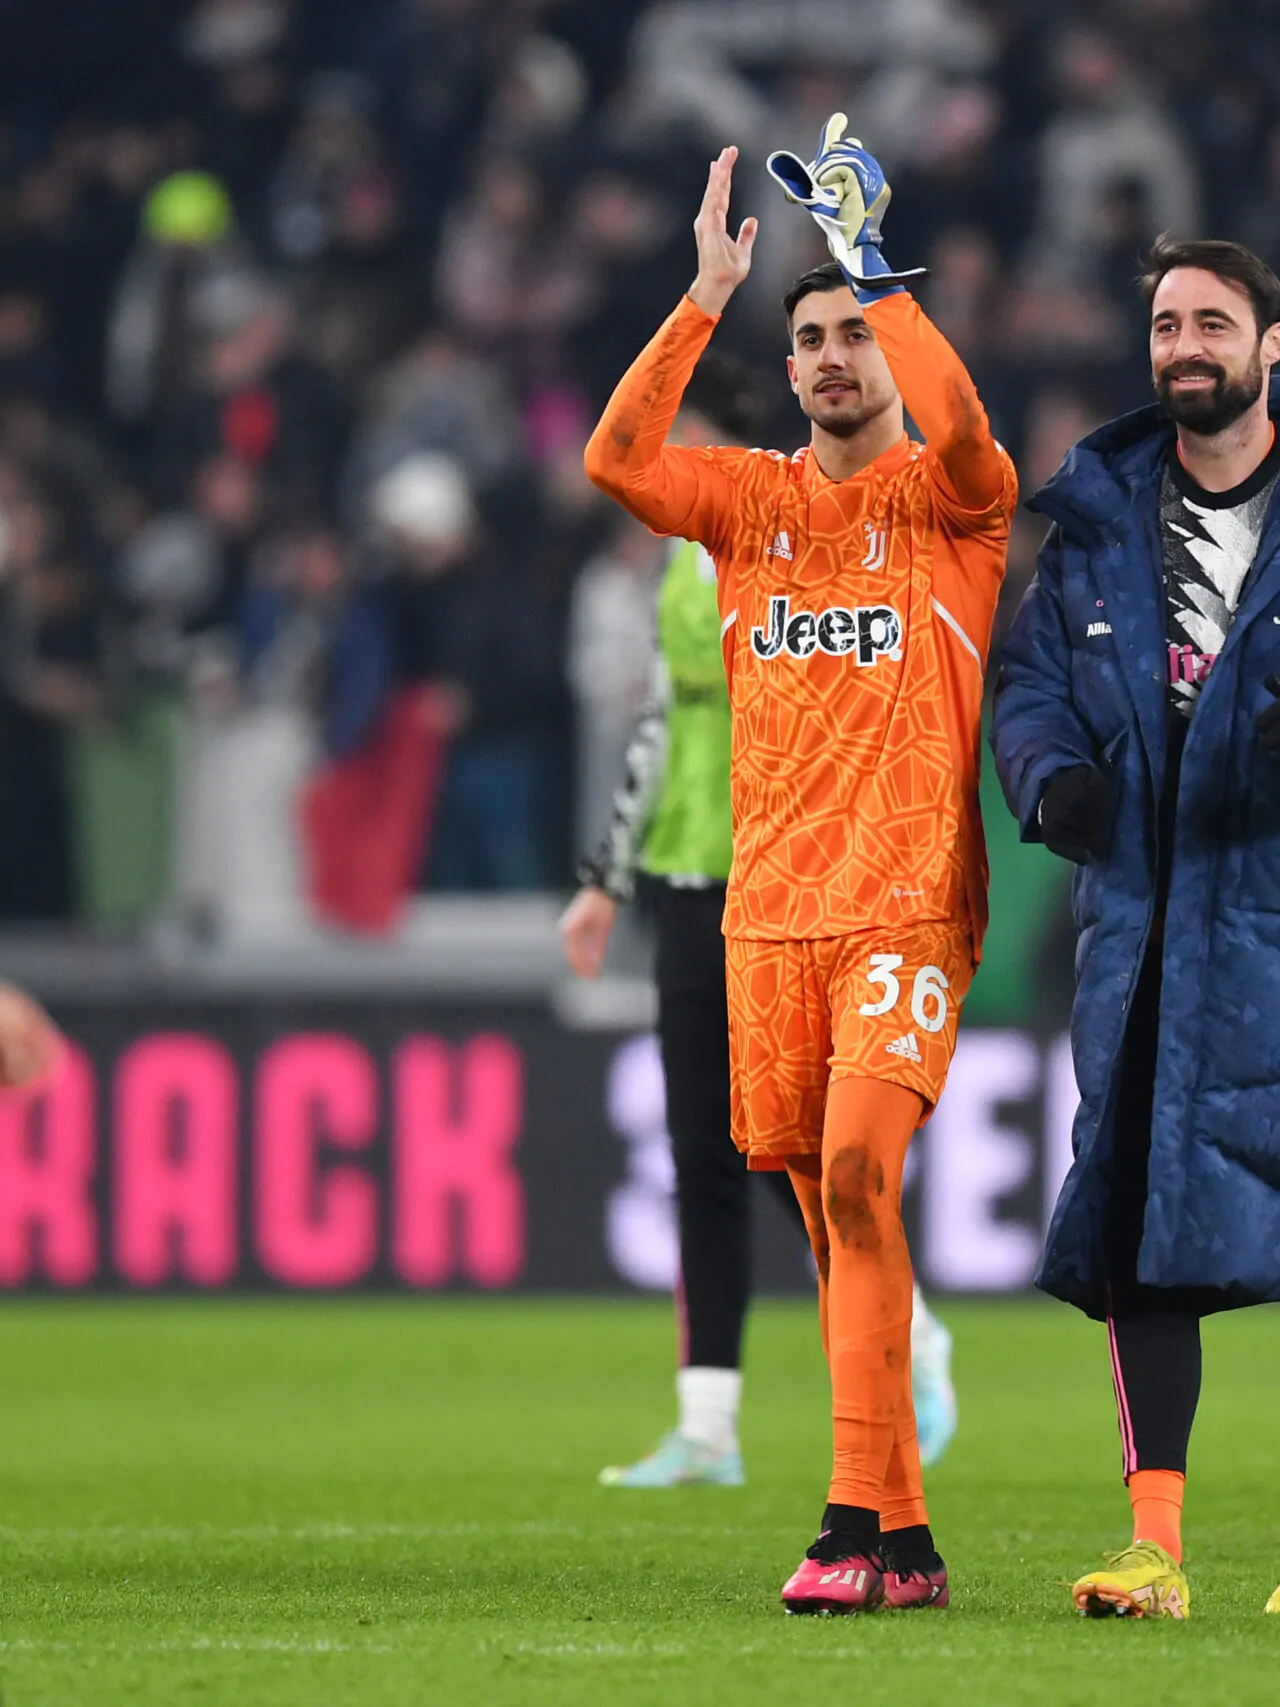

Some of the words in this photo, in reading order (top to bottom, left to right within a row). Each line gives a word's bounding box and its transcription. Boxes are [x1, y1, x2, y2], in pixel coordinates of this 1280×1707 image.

[766, 546, 793, 561] adas
[751, 596, 902, 667] Jeep
[859, 953, 949, 1033] 36
